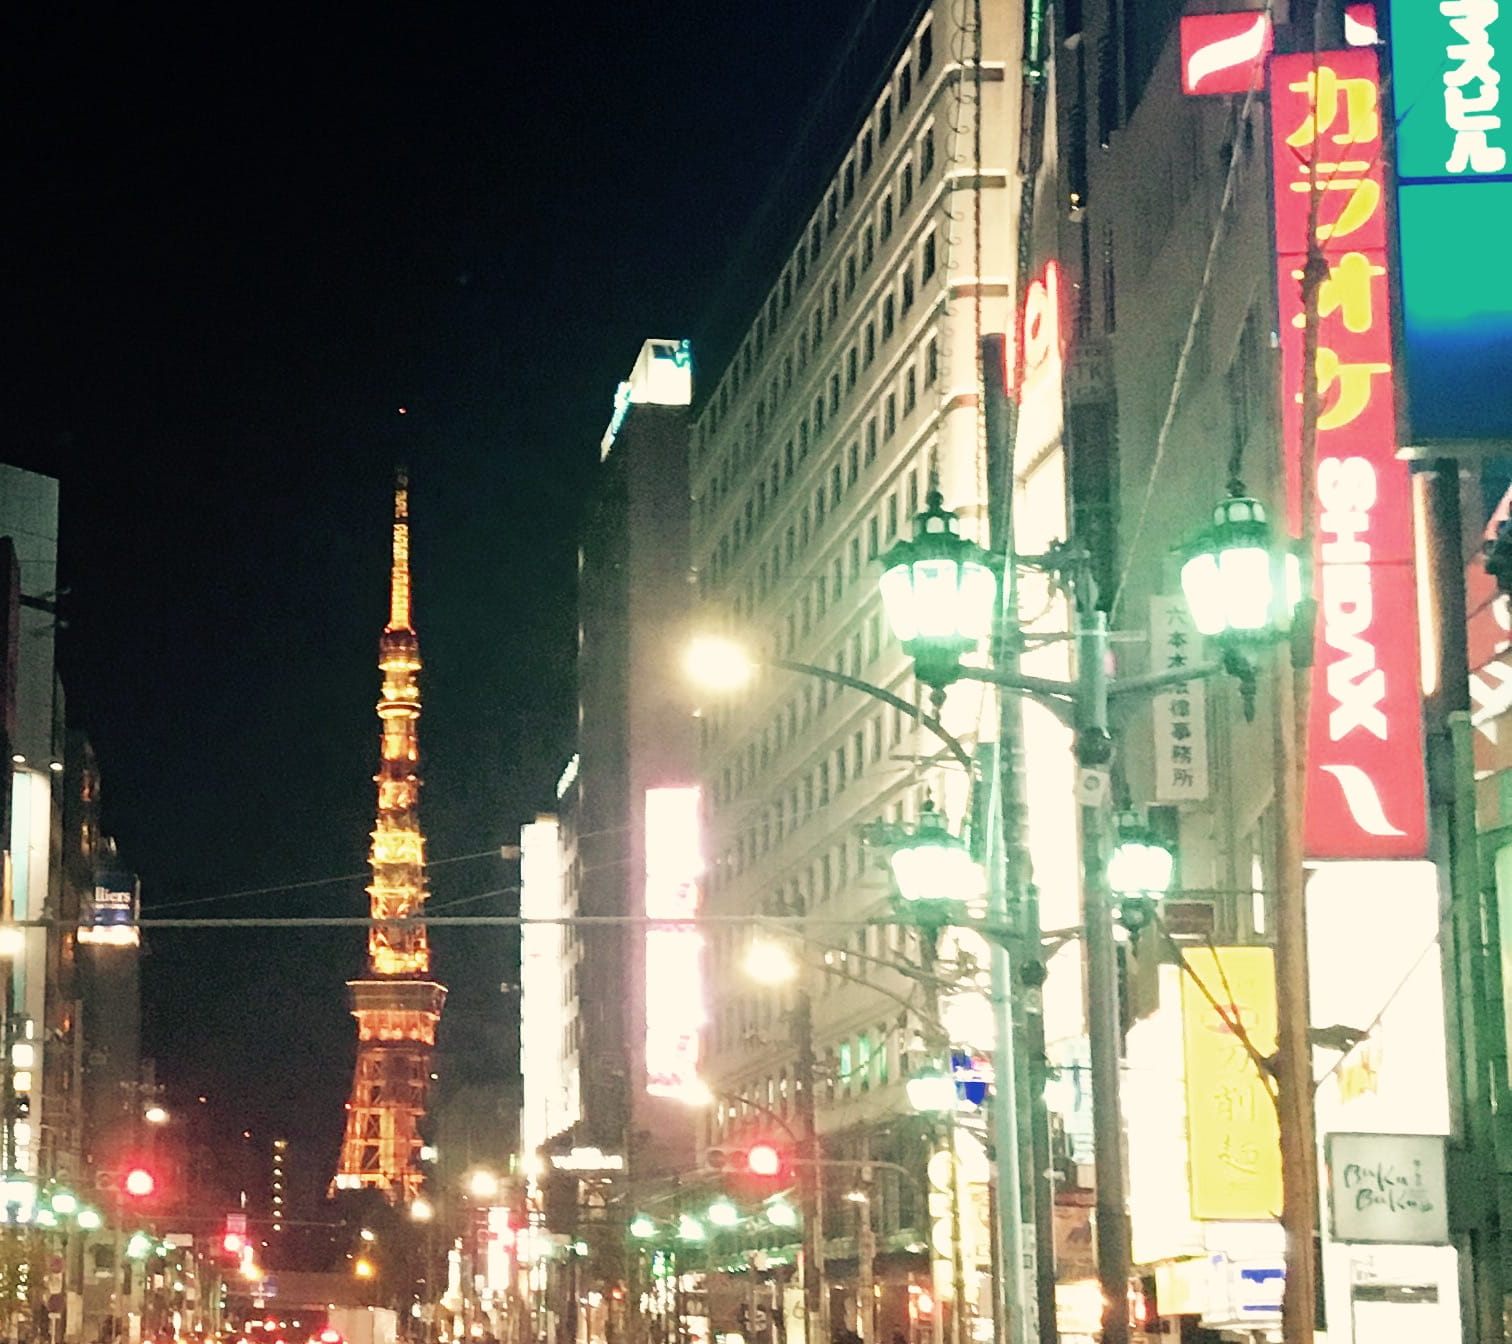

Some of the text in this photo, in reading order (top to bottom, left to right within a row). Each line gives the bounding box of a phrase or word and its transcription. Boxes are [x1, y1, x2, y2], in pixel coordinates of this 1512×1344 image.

[1286, 65, 1392, 431] カラオケ
[1316, 456, 1389, 742] SHIDAX
